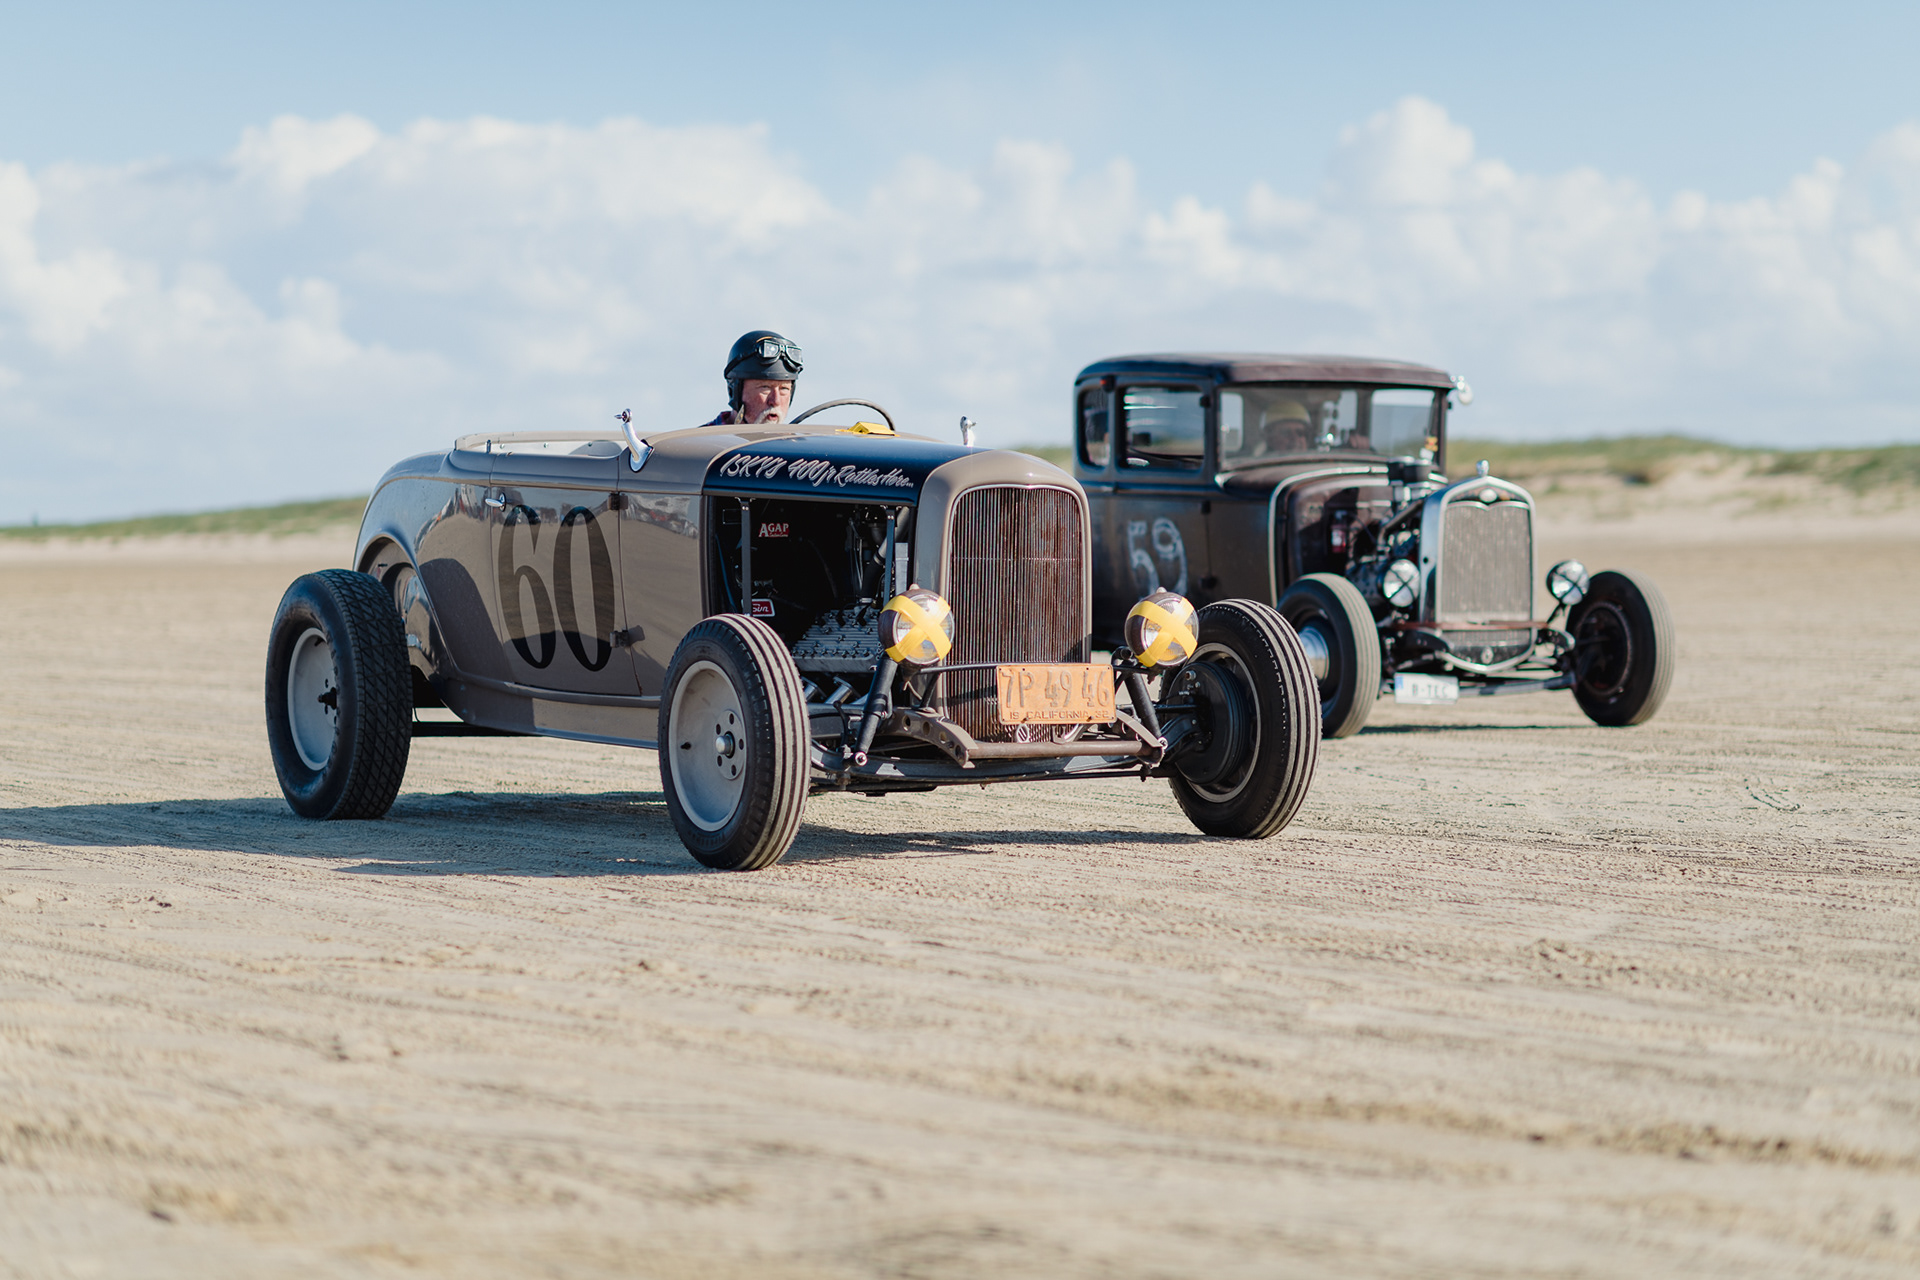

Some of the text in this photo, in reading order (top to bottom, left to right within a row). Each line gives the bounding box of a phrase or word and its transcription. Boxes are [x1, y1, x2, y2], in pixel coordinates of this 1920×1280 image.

[758, 522, 789, 538] AGAP
[1127, 517, 1188, 599] 59
[498, 504, 615, 672] 60
[1001, 669, 1110, 708] 7P 49 46
[1025, 709, 1090, 720] CALIFORNIA
